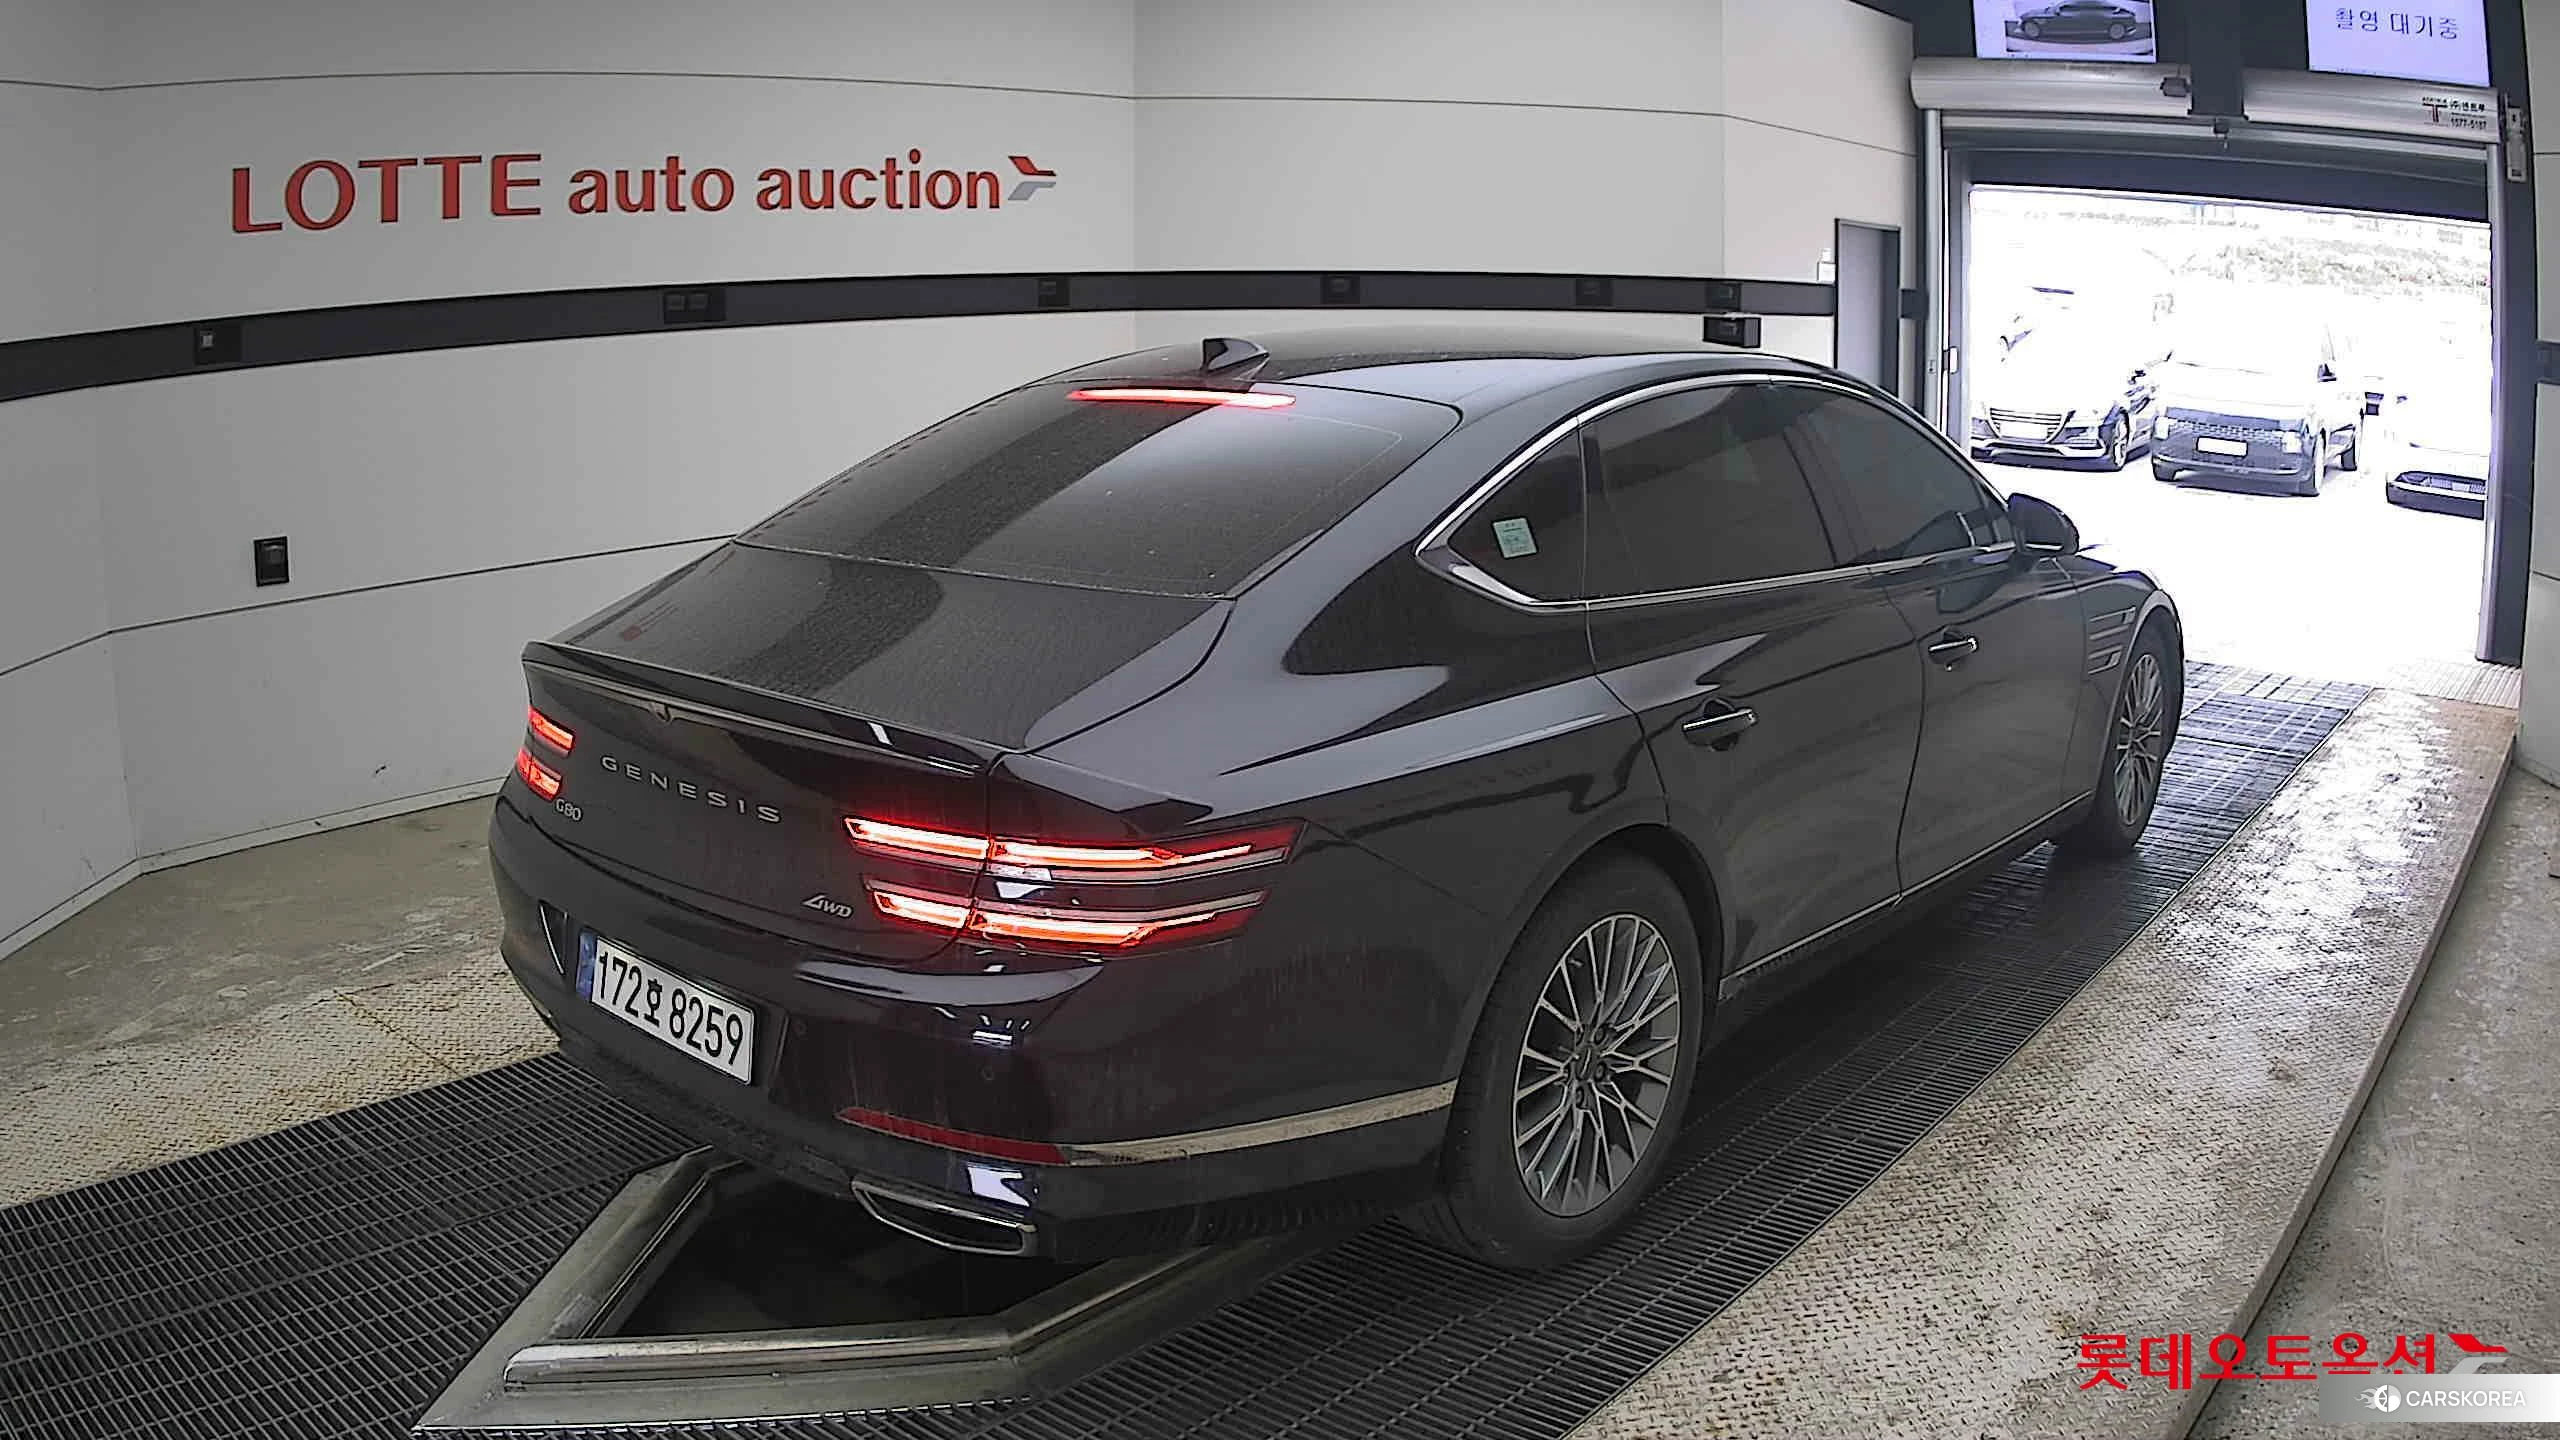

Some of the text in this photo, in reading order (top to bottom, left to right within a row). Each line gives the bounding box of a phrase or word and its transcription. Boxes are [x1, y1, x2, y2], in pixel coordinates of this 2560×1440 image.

[2336, 8, 2378, 32] 촬영
[232, 148, 1000, 233] LOTTE auto auction
[554, 798, 582, 822] G80
[601, 755, 782, 823] GENESIS
[599, 951, 744, 1066] 172호 8259
